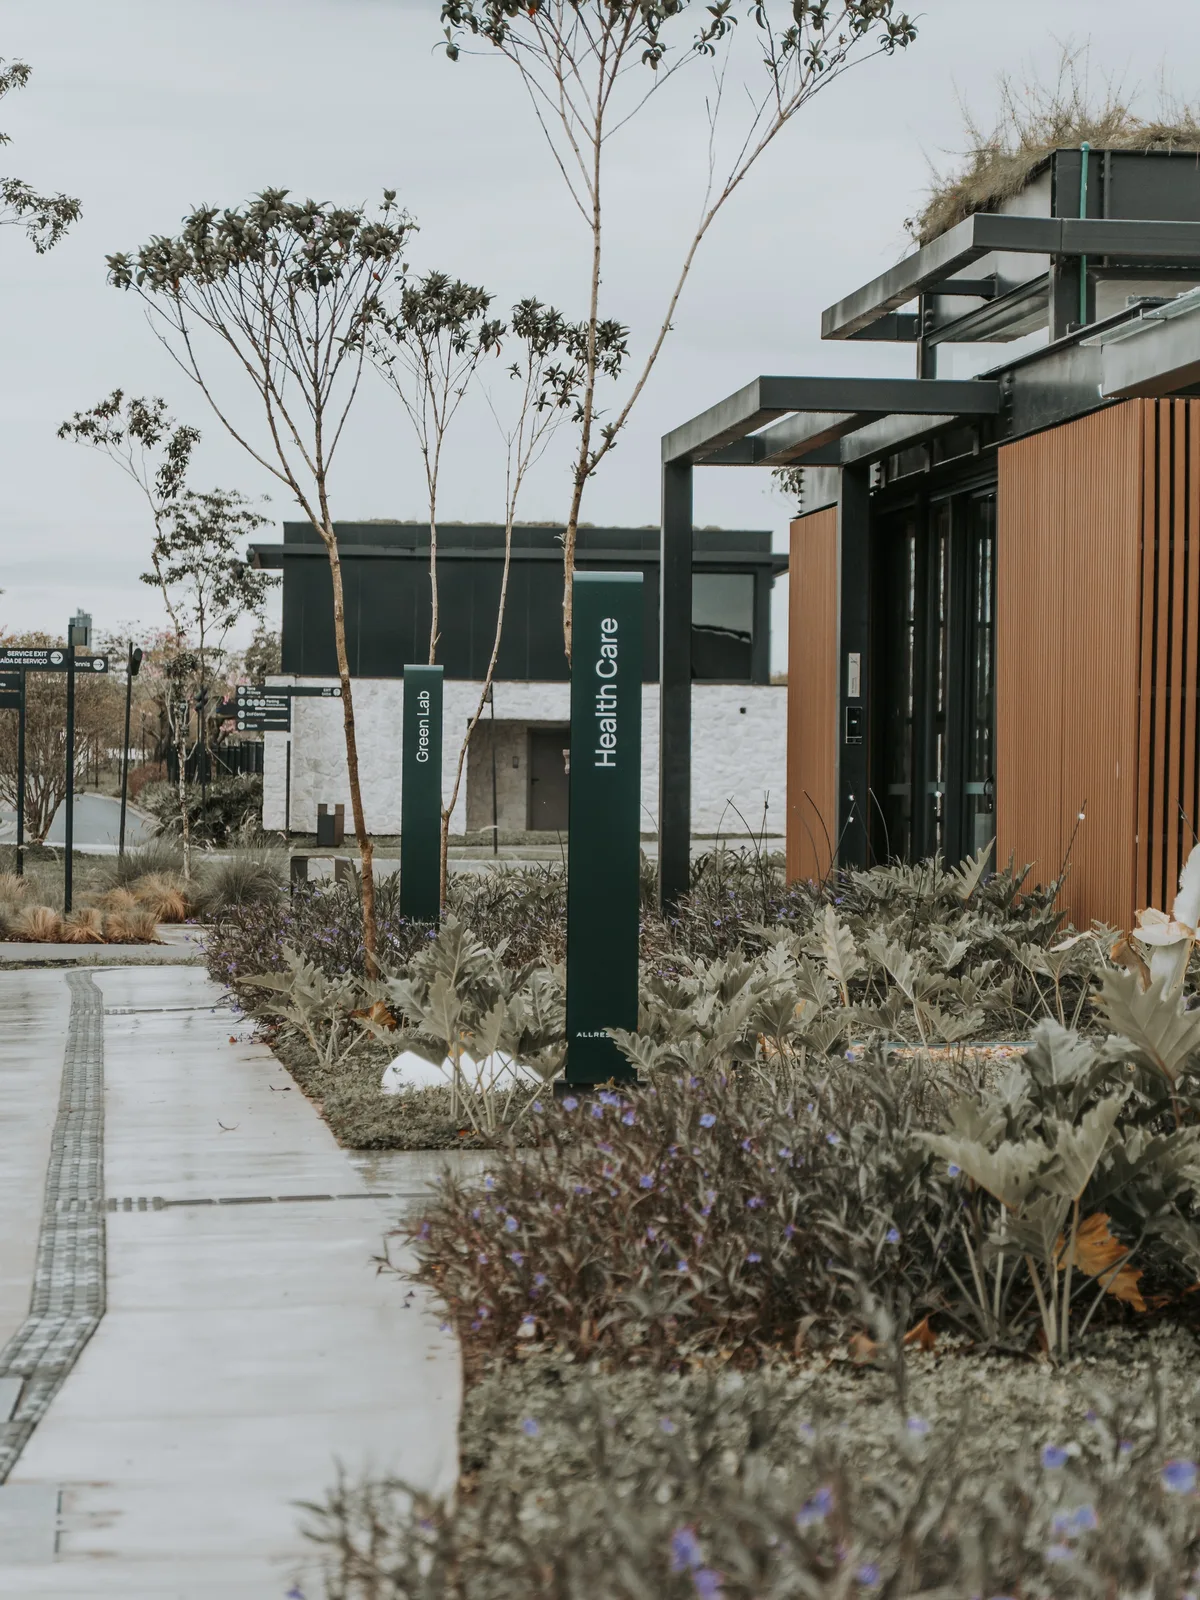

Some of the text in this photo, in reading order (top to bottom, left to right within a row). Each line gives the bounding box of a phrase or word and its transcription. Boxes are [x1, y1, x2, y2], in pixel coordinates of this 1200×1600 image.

[0, 656, 14, 664] AÍDA
[22, 657, 48, 666] SERVIÇO
[594, 617, 619, 767] Health Care
[416, 690, 430, 763] Green Lab
